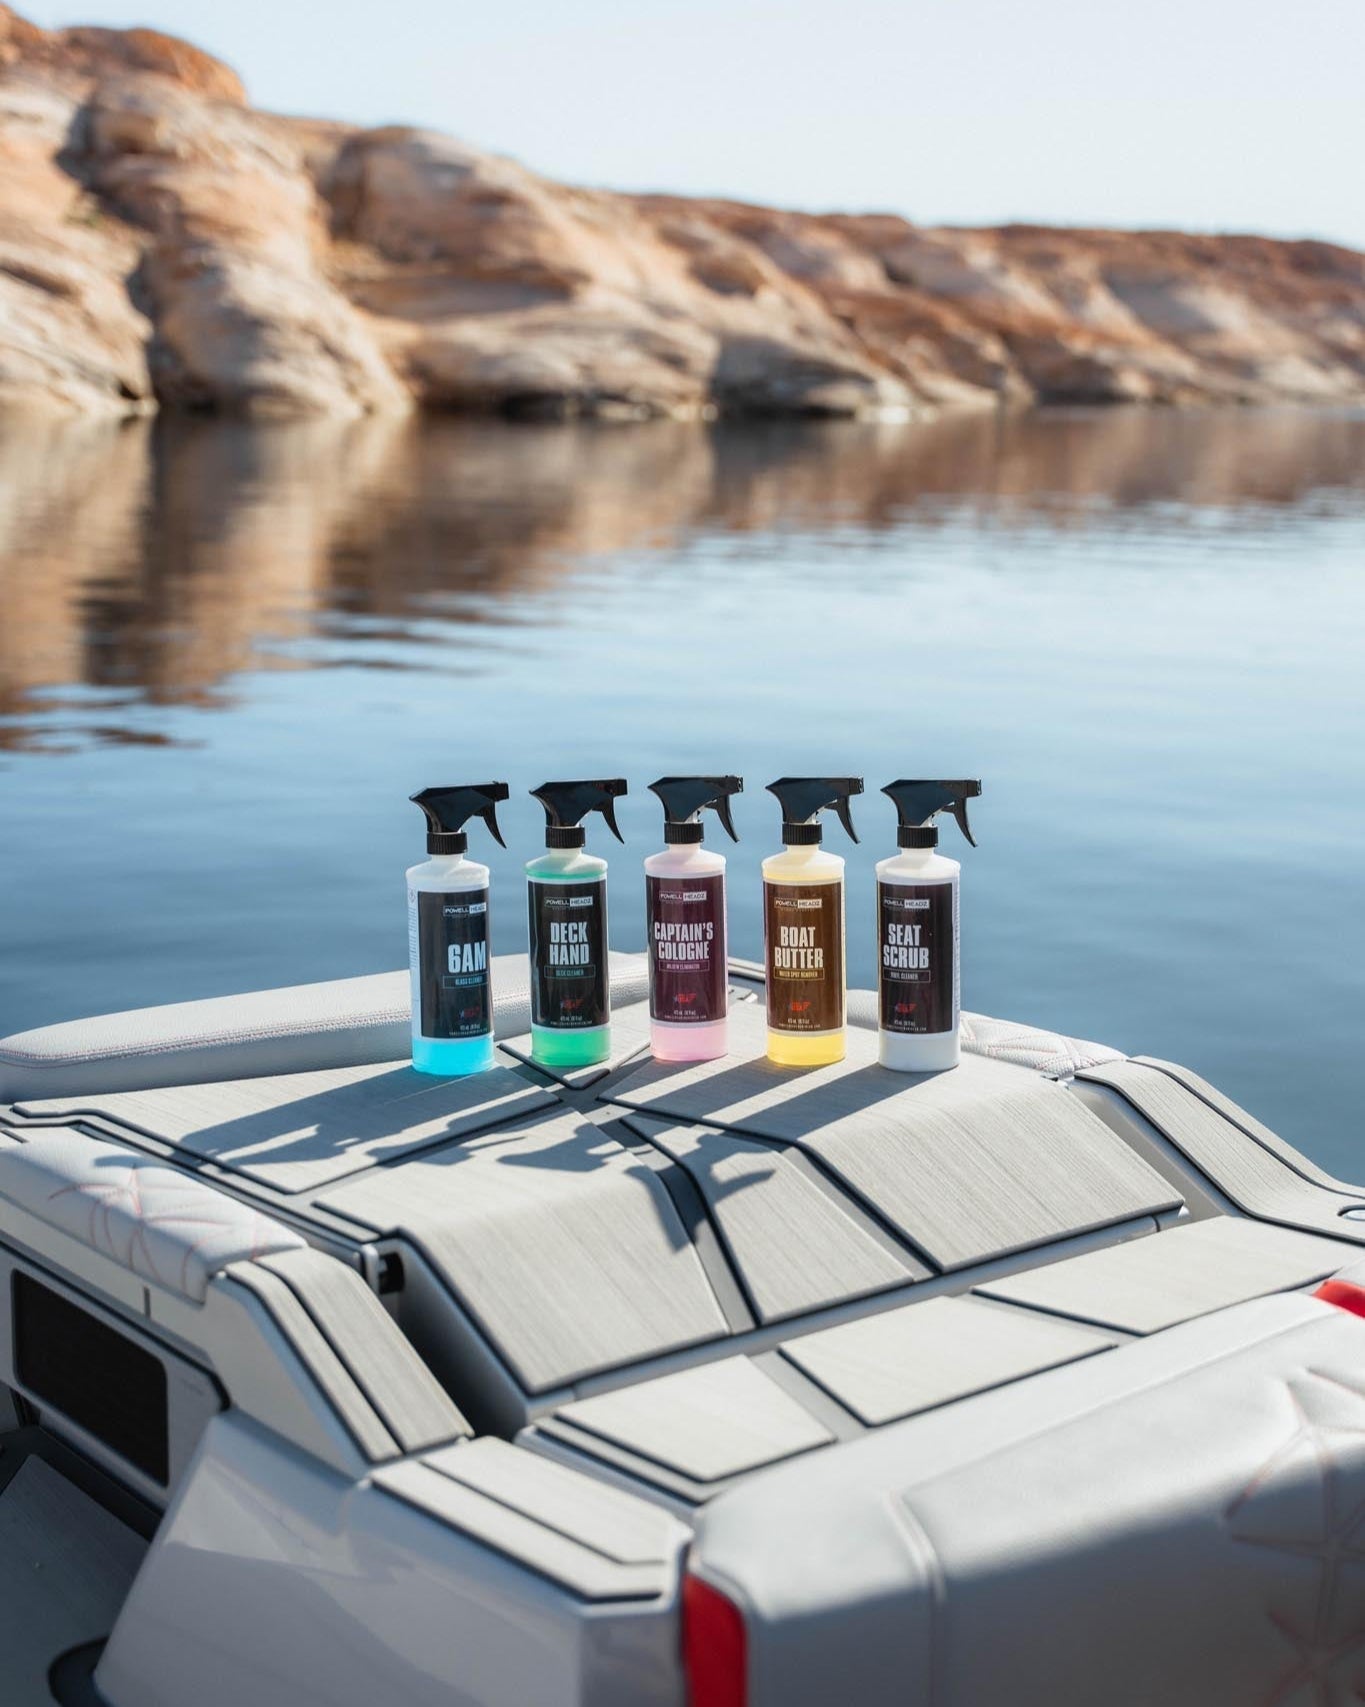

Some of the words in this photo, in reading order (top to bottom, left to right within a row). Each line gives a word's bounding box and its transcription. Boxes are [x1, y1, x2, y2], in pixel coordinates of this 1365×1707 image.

[550, 922, 588, 943] DECK
[654, 921, 714, 942] CAPTAIN'S
[780, 925, 816, 947] BOAT
[888, 923, 922, 947] SEAT
[447, 940, 487, 974] 6AM
[549, 943, 590, 966] HAND
[658, 941, 710, 960] COLOGNE
[774, 946, 824, 969] BUTTER
[883, 944, 929, 969] SCRUB
